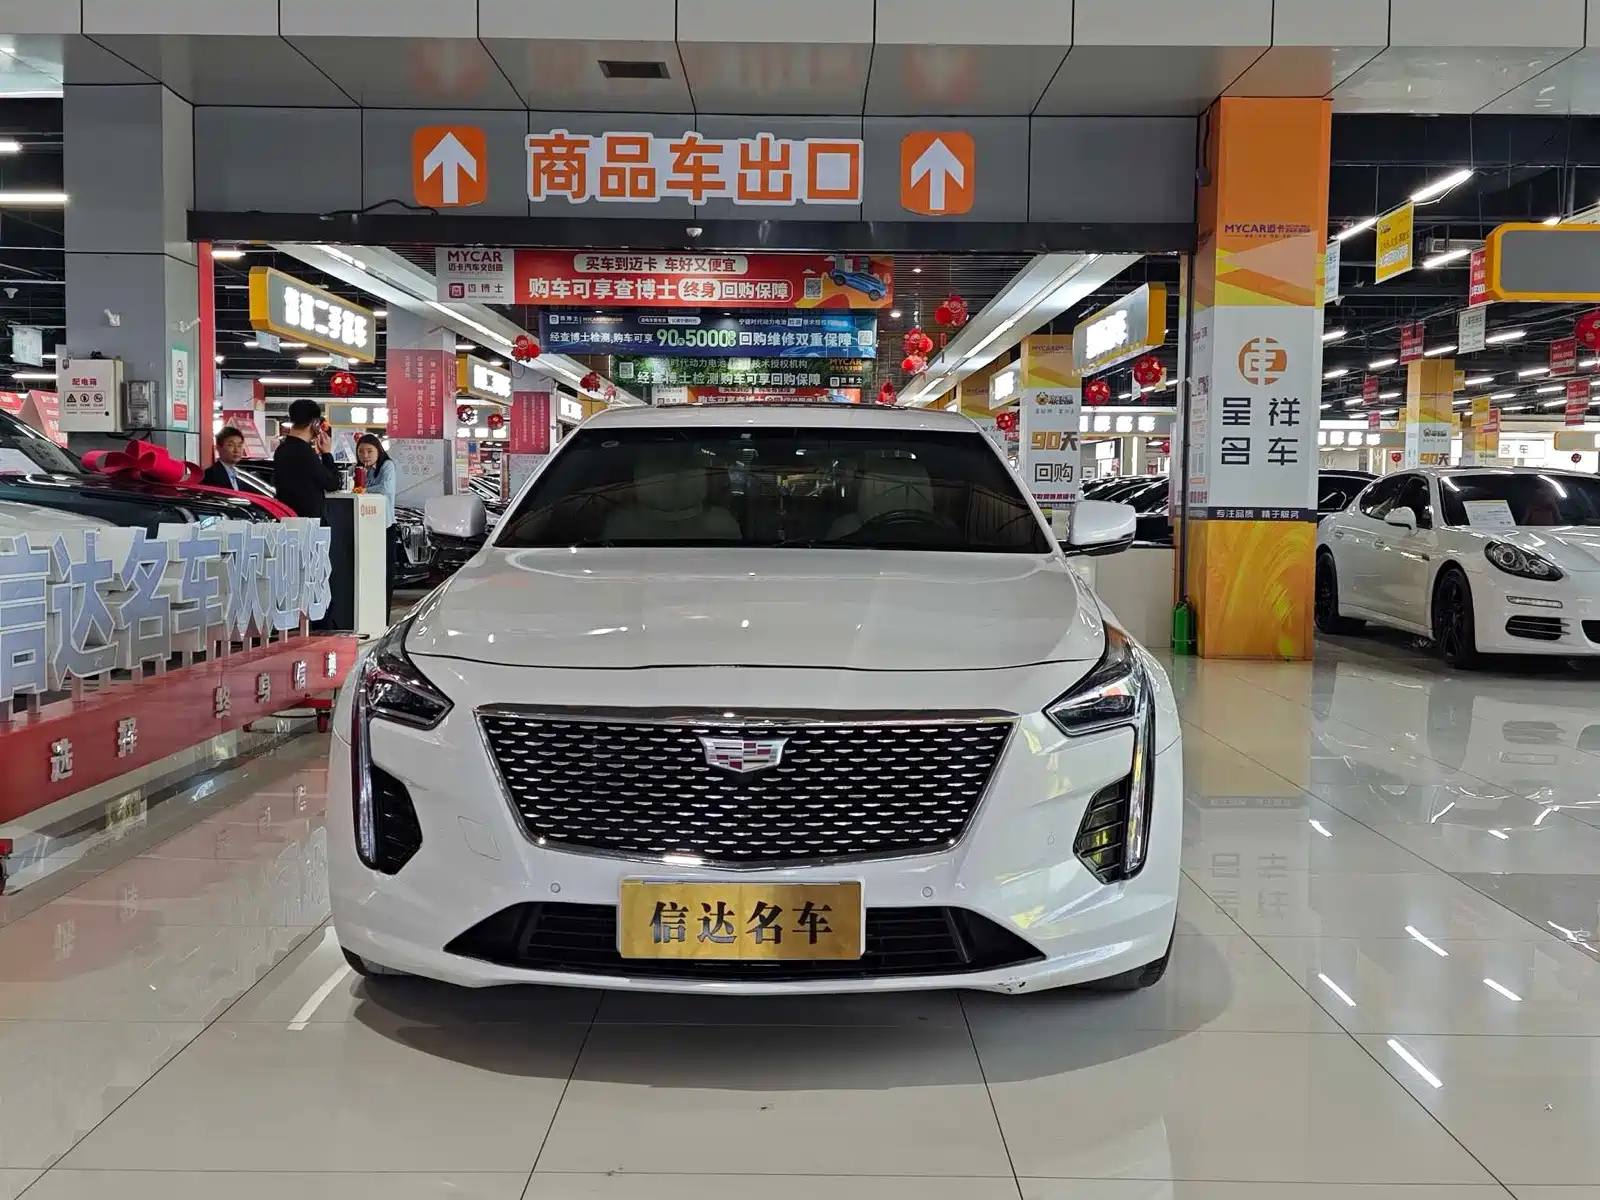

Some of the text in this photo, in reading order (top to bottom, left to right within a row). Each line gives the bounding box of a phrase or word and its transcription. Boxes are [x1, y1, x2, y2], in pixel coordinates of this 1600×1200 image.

[526, 131, 863, 203] 商品车出口
[448, 250, 502, 262] MYCAR
[586, 256, 737, 272] 买车到迈卡 车好又便宜
[739, 331, 851, 347] 回购维修双重保障
[72, 378, 97, 386] 配电箱
[1031, 432, 1078, 451] 90天
[1035, 463, 1073, 483] 回购
[650, 901, 833, 945] 信达名车
